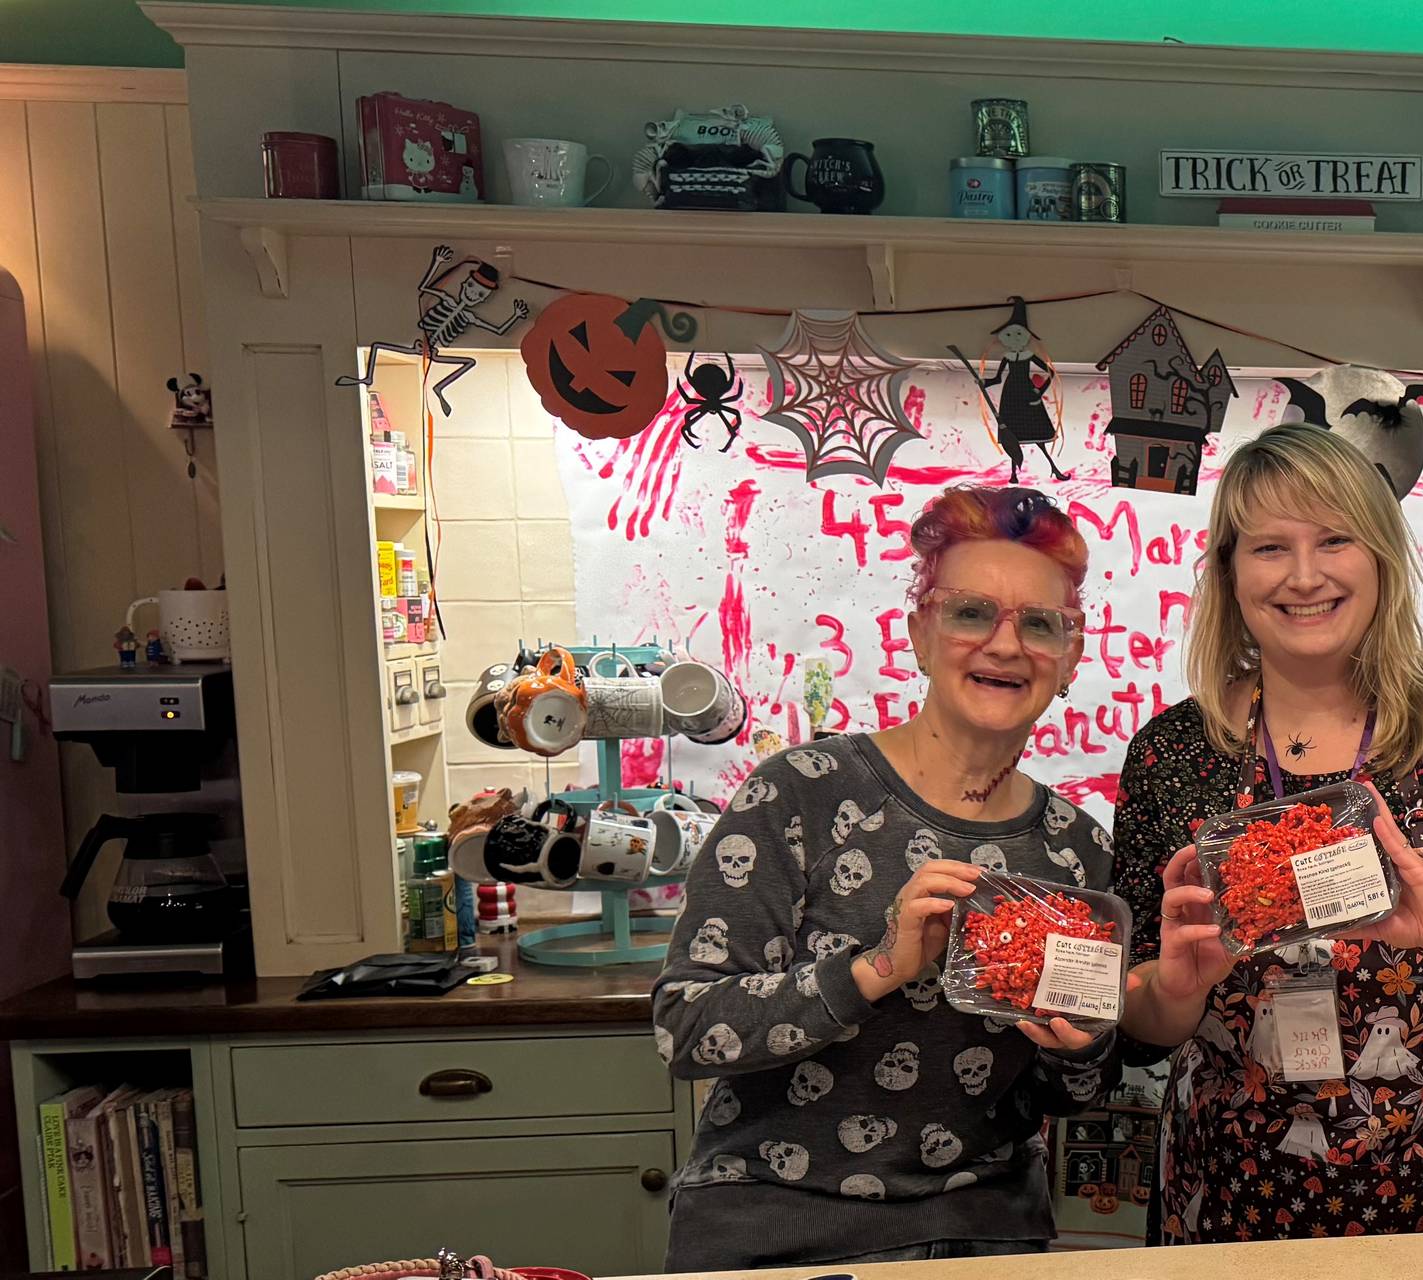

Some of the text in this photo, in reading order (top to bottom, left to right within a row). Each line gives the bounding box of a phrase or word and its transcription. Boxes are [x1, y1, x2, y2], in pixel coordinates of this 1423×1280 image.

[1166, 156, 1415, 194] TRICK OR TREAT
[958, 191, 994, 203] Pastry
[1253, 220, 1343, 232] COOKIE CUTTER
[374, 461, 393, 469] SALT
[821, 489, 942, 567] 45
[816, 614, 853, 678] 3
[73, 693, 111, 708] Mondo
[1313, 846, 1347, 862] COTTAGE
[1367, 892, 1379, 901] 5,81
[43, 1115, 53, 1146] CLAIRE
[56, 1175, 66, 1198] CAKE
[145, 1184, 162, 1218] BAKING
